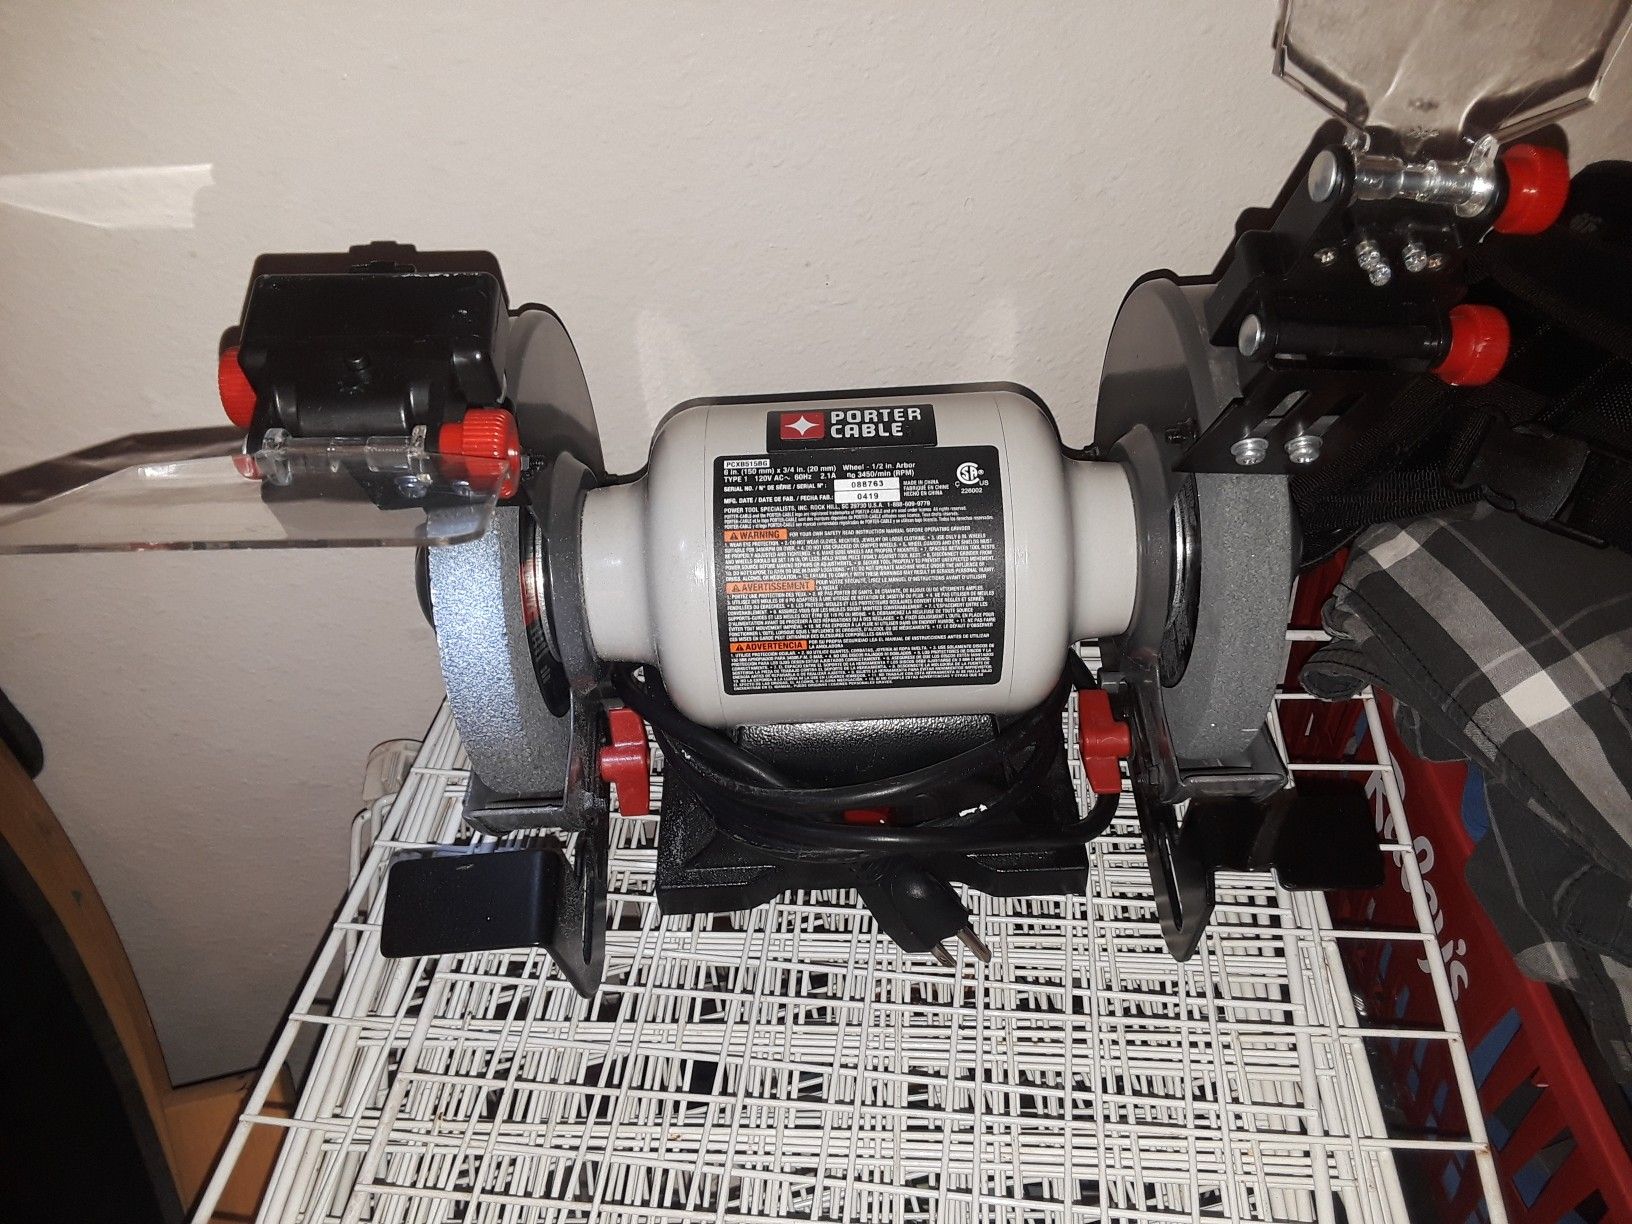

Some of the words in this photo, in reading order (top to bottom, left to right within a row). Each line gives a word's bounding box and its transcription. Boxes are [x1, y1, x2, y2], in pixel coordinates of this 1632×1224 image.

[830, 407, 922, 424] PORTER
[830, 422, 904, 438] CABLE
[857, 470, 890, 478] 3450/min
[893, 469, 914, 477] (RPM)
[956, 462, 979, 484] CSA
[740, 531, 779, 539] WARNING
[742, 581, 809, 591] AVERTISSEMENT
[745, 642, 802, 650] ADVERTENCIA
